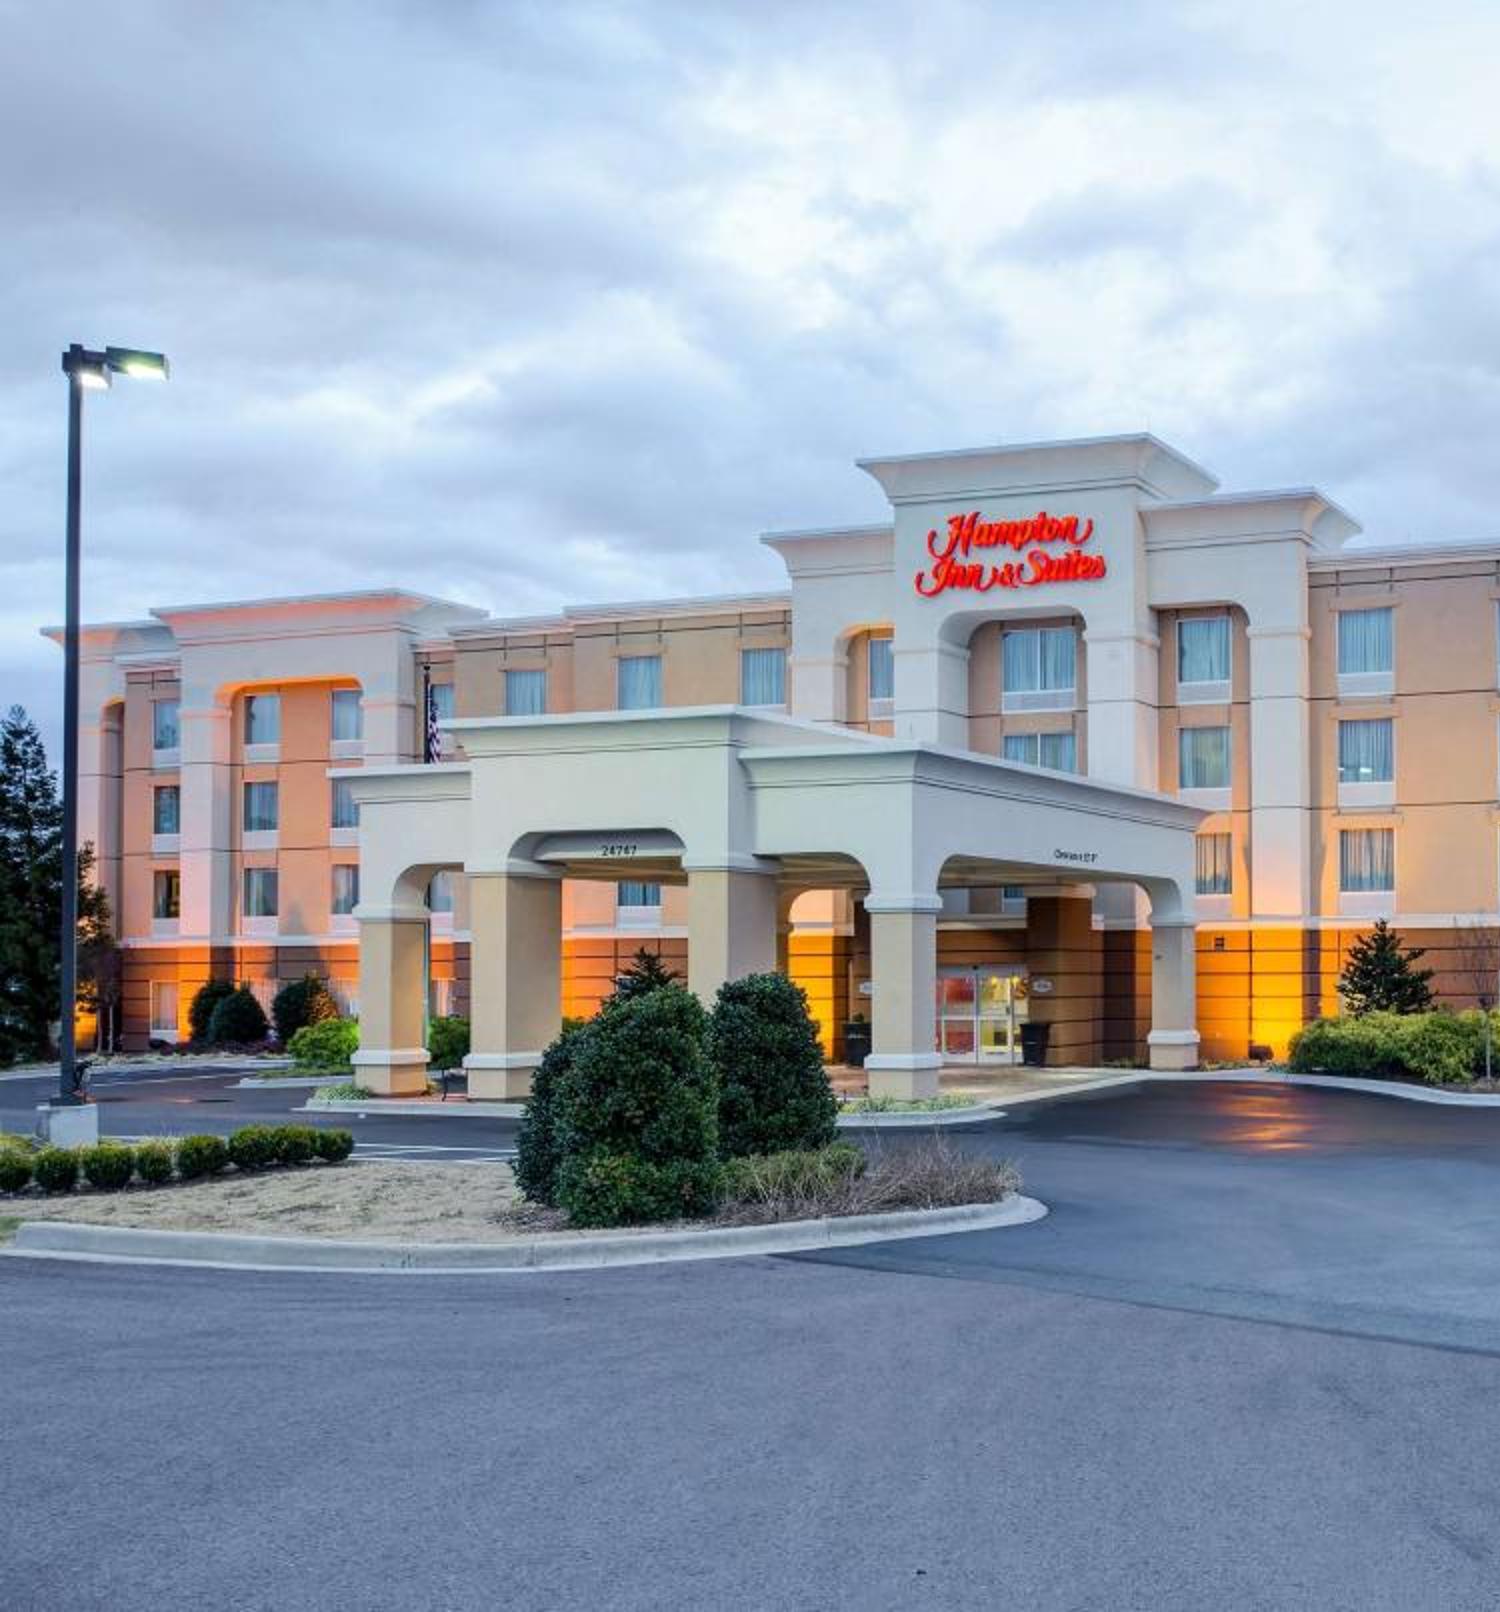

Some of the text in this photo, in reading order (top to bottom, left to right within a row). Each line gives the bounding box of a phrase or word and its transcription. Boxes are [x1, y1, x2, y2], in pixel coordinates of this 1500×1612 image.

[928, 511, 1093, 559] Hampton
[915, 549, 1107, 598] Inn & Suites
